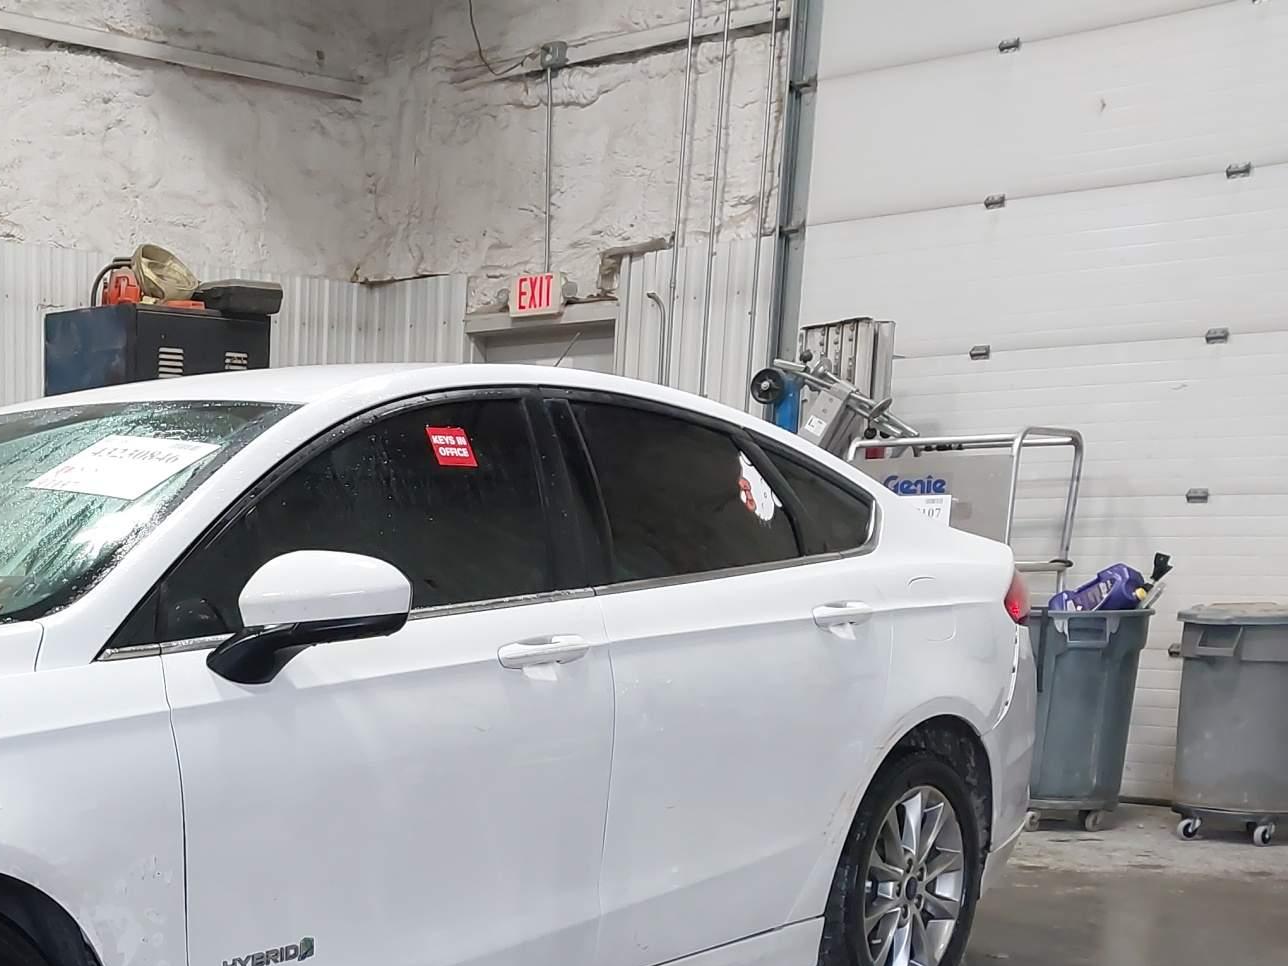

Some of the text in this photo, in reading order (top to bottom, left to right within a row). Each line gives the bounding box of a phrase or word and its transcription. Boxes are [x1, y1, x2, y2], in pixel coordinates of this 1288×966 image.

[518, 275, 553, 310] EXIT
[432, 434, 467, 446] KEYS IN
[438, 446, 469, 457] OFFICE
[884, 475, 946, 495] Genie
